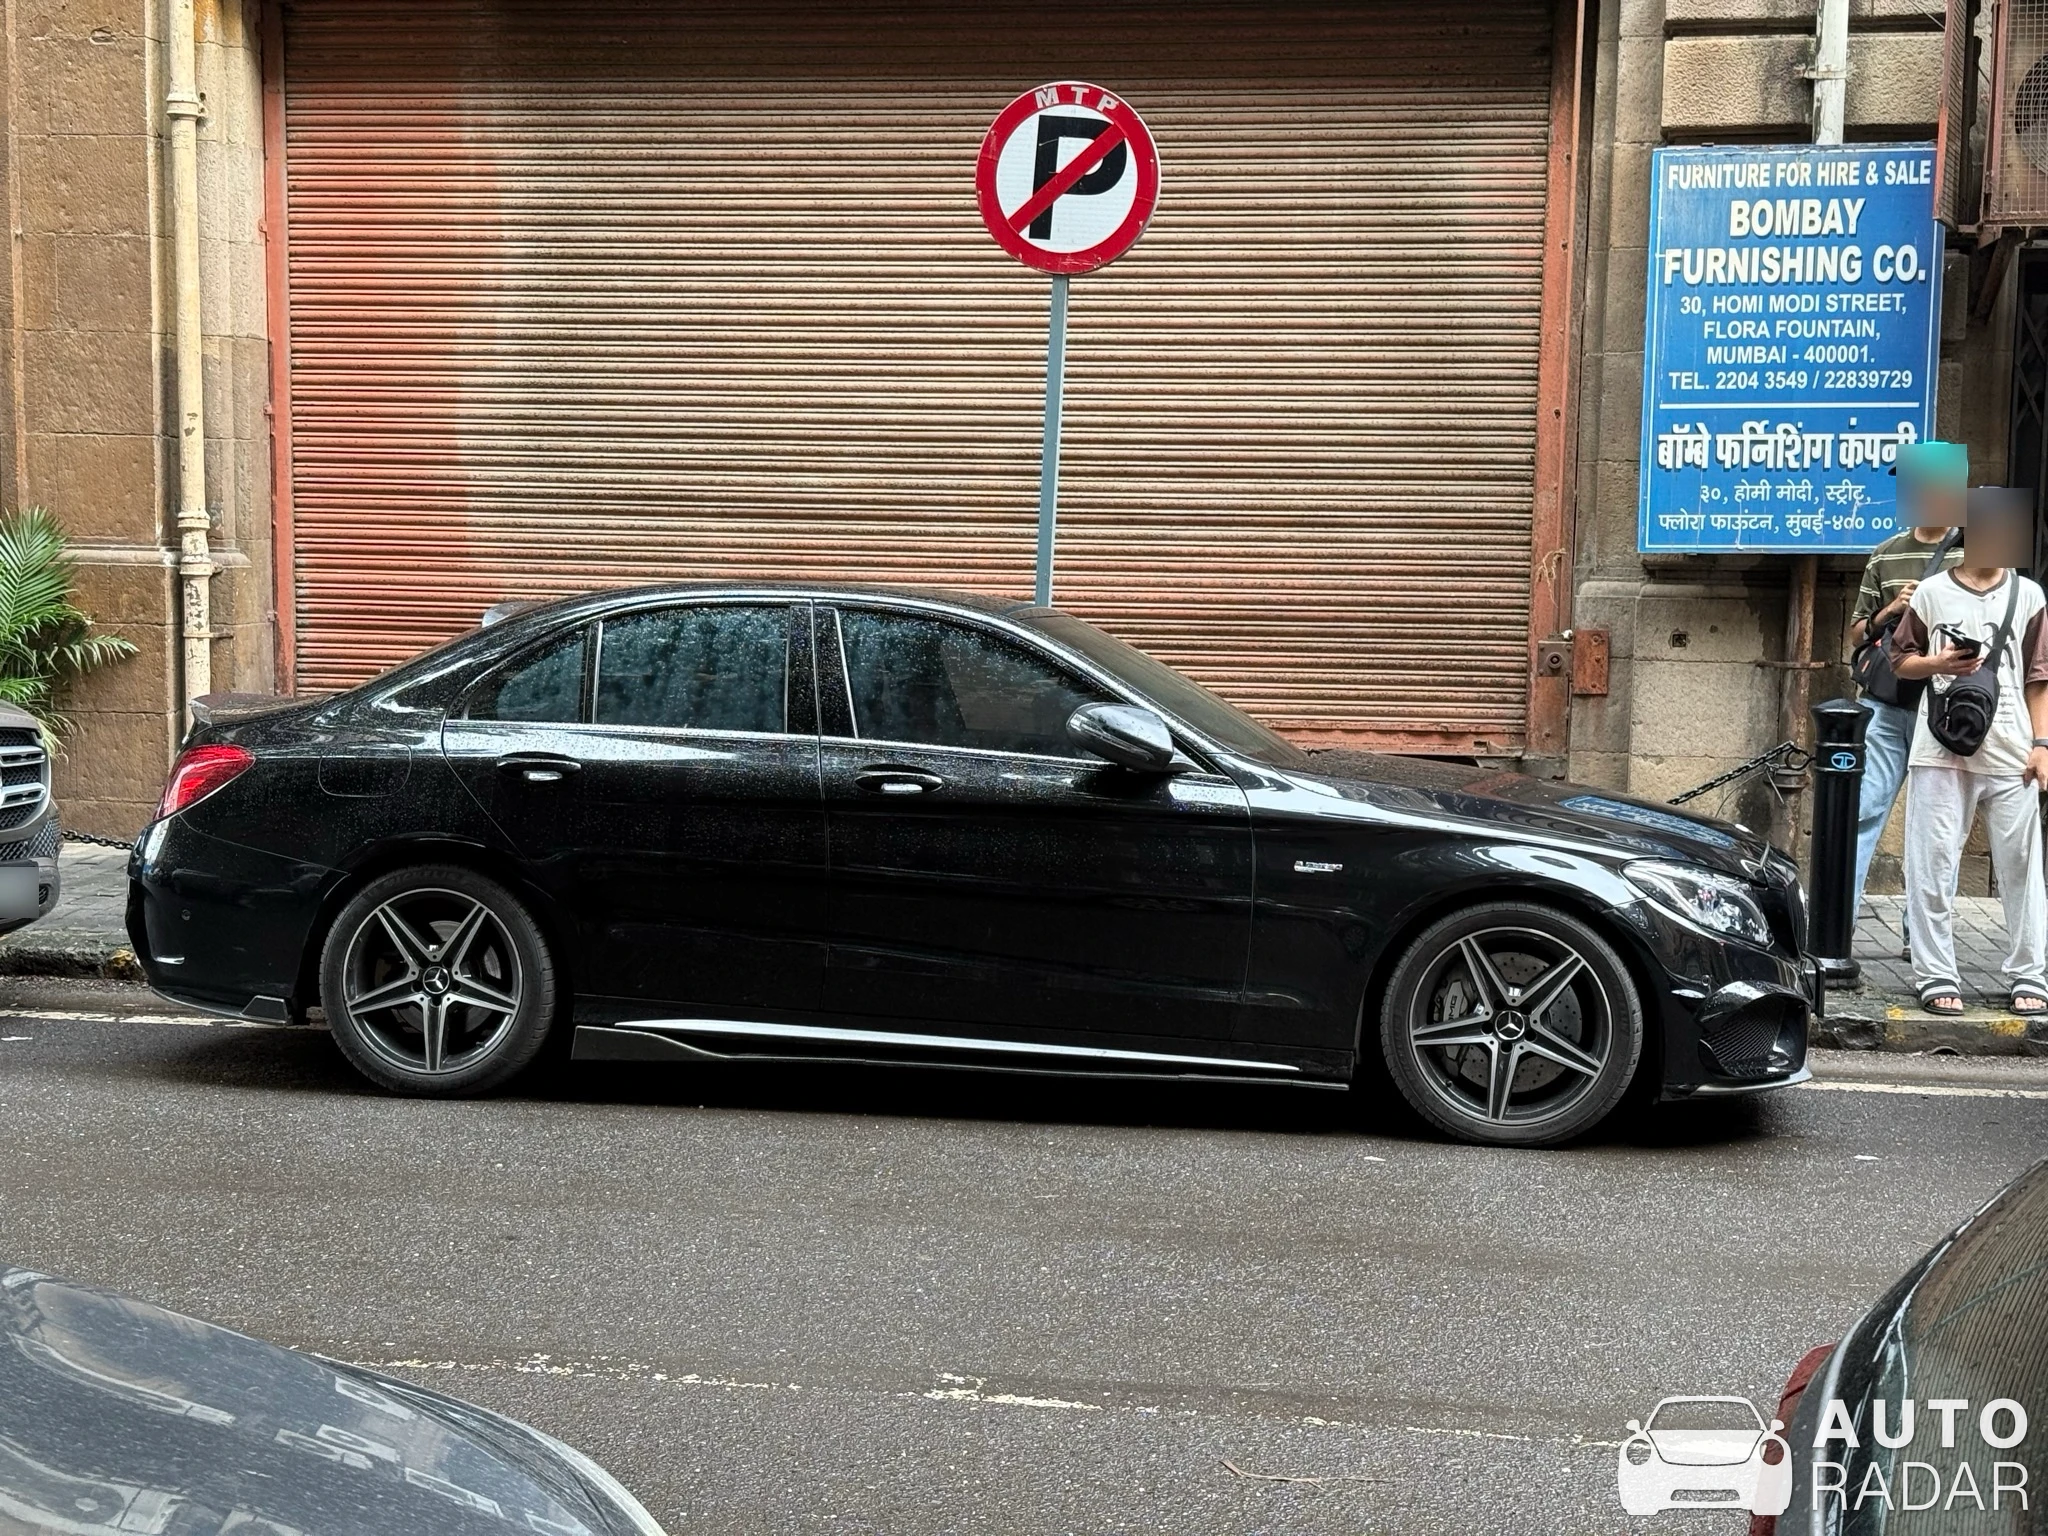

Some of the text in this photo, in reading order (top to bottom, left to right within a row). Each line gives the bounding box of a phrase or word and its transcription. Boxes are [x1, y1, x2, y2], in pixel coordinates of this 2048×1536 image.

[1668, 160, 1931, 190] FURNITURE FOR HIRE & SALE
[1729, 198, 1866, 238] BOMBAY
[1664, 244, 1926, 286] FURNISHING CO.
[1679, 293, 1907, 317] 30, HOMI MODI STREET,
[1703, 319, 1881, 341] FLORA FOUNTAIN,
[1706, 346, 1787, 364] MUMBAI
[1803, 345, 1876, 363] 400001.
[1668, 370, 1913, 390] TEL. 2204 3549 / 22839729
[1657, 423, 1710, 470] बॉम्बे
[1715, 420, 1834, 469] फर्निशिंग
[1700, 478, 1871, 505] ३०, होमी मोदी, स्ट्रीट,
[1658, 508, 1705, 530] फ्लोरा
